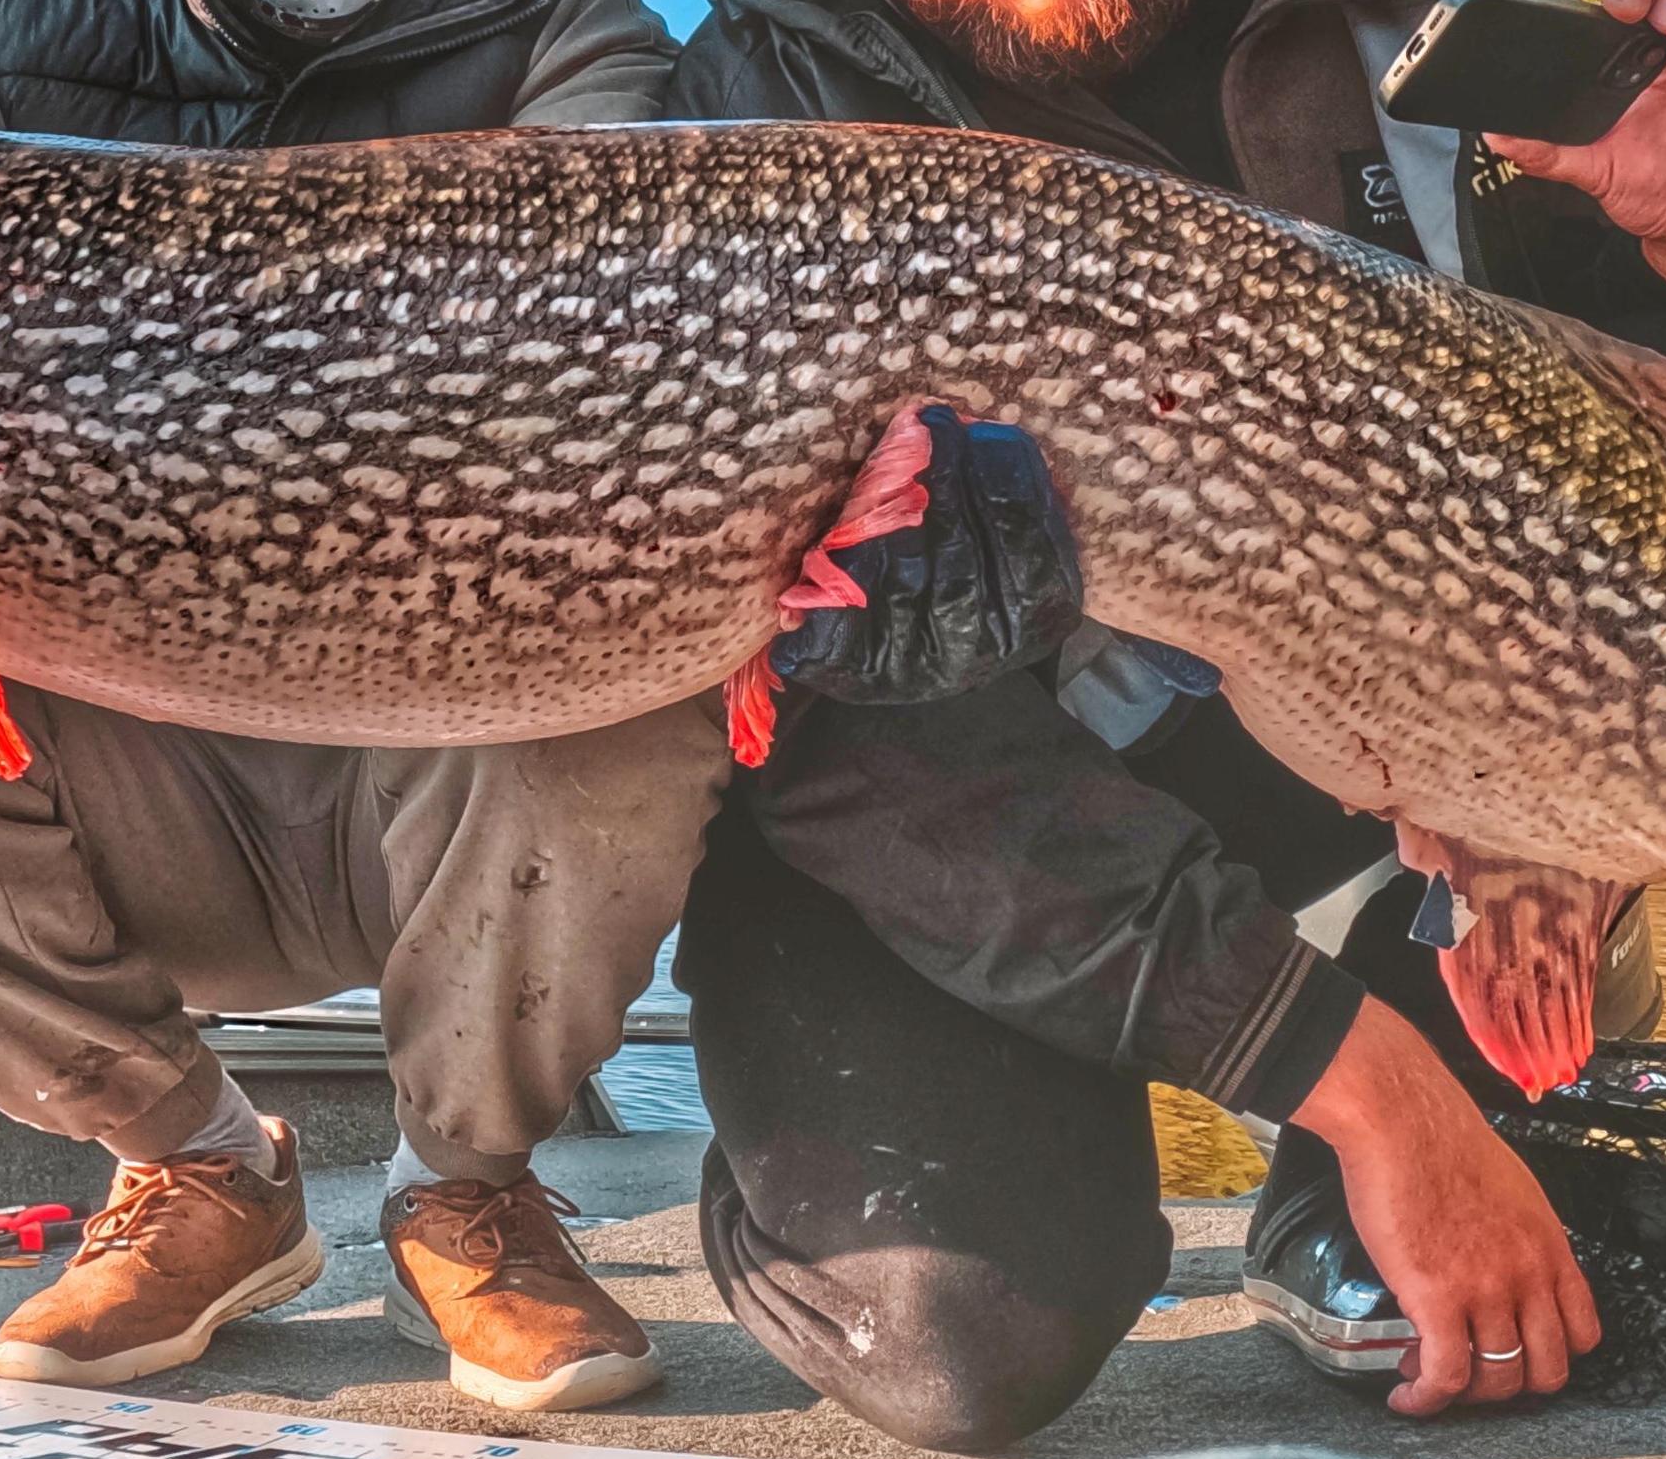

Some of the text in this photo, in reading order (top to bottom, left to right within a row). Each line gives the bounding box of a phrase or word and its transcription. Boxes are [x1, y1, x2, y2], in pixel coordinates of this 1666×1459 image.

[105, 1401, 154, 1414] 50
[276, 1424, 328, 1436] 60
[474, 1444, 520, 1457] 70
